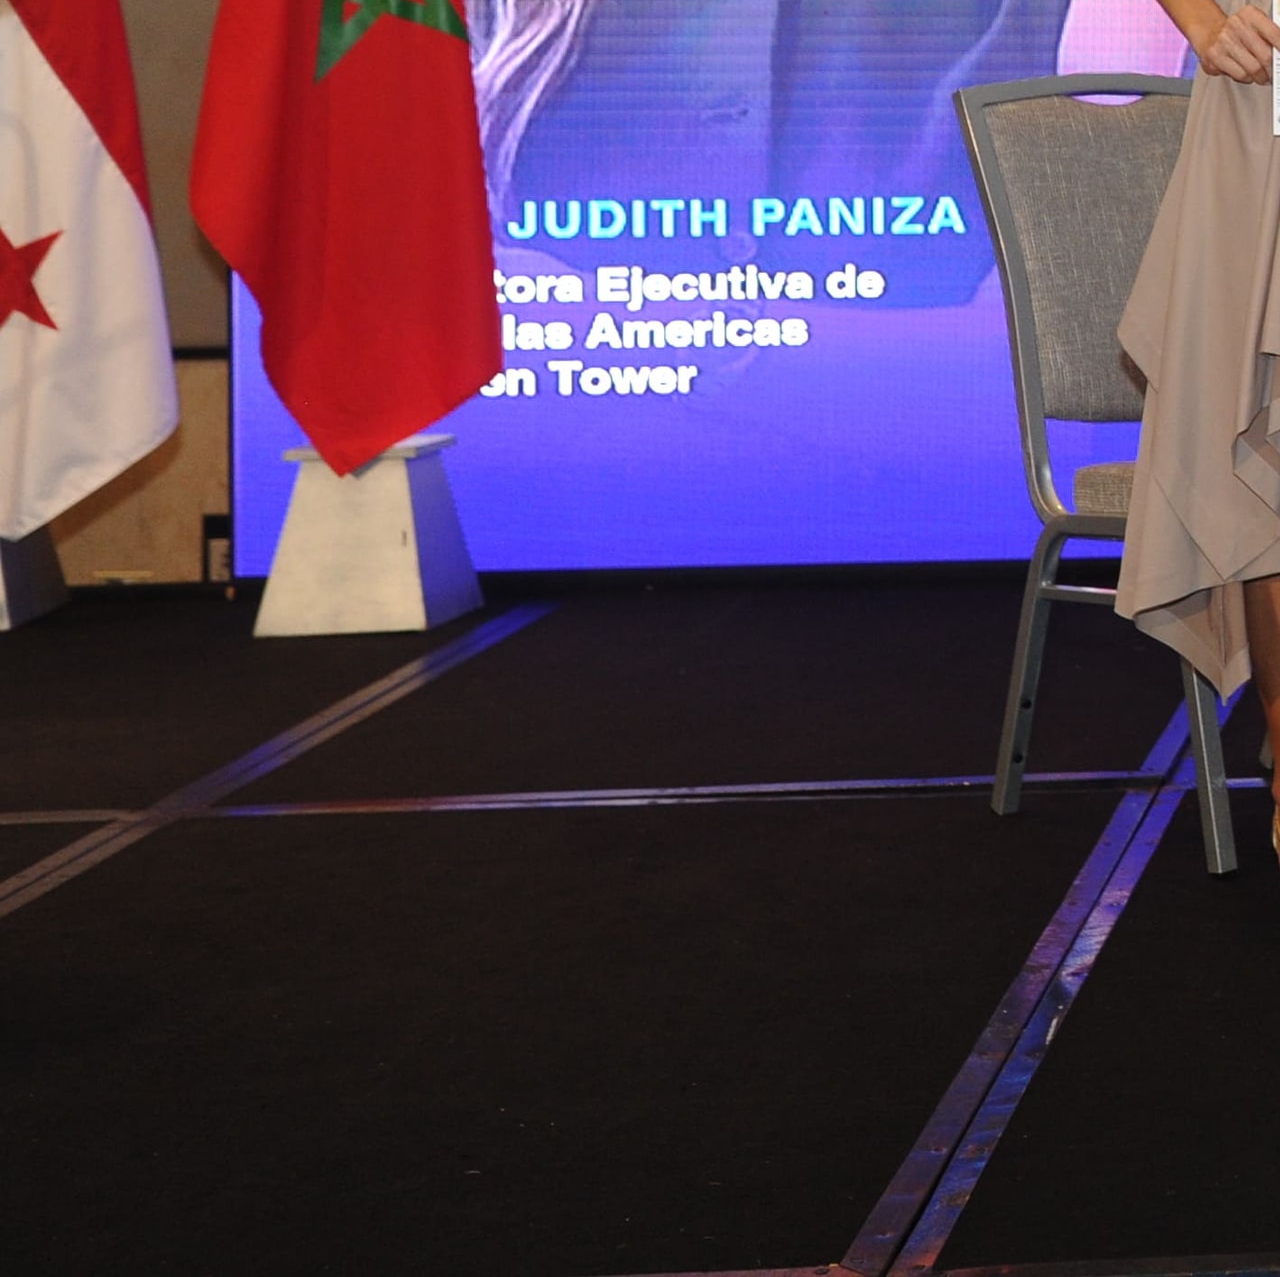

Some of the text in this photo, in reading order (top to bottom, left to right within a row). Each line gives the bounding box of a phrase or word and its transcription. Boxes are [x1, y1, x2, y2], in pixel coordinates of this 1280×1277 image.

[507, 195, 966, 240] JUDITH PANIZA
[596, 264, 814, 313] Ejecutiva
[825, 262, 886, 299] de
[502, 310, 809, 351] las Americas
[547, 359, 698, 396] Tower
